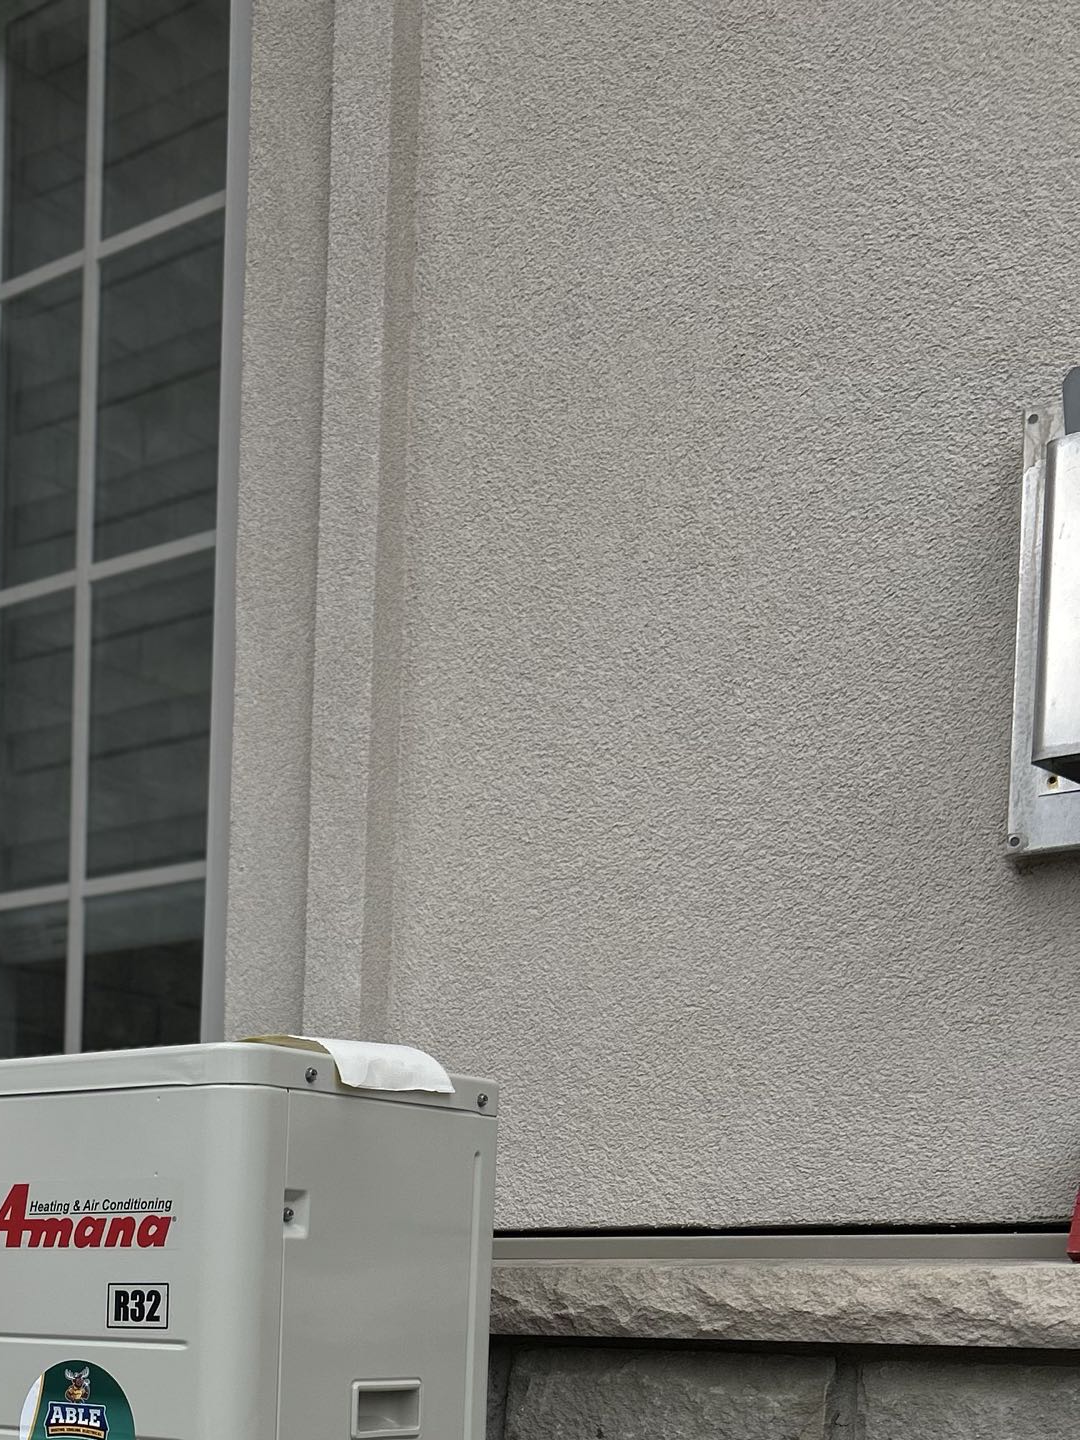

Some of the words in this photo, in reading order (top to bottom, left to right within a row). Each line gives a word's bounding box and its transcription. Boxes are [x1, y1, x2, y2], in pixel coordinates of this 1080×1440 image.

[29, 1200, 70, 1214] Heating
[73, 1199, 81, 1212] &
[83, 1199, 100, 1212] Air
[102, 1197, 172, 1213] Conditioning
[114, 1289, 162, 1322] R32
[50, 1406, 101, 1427] ABLE
